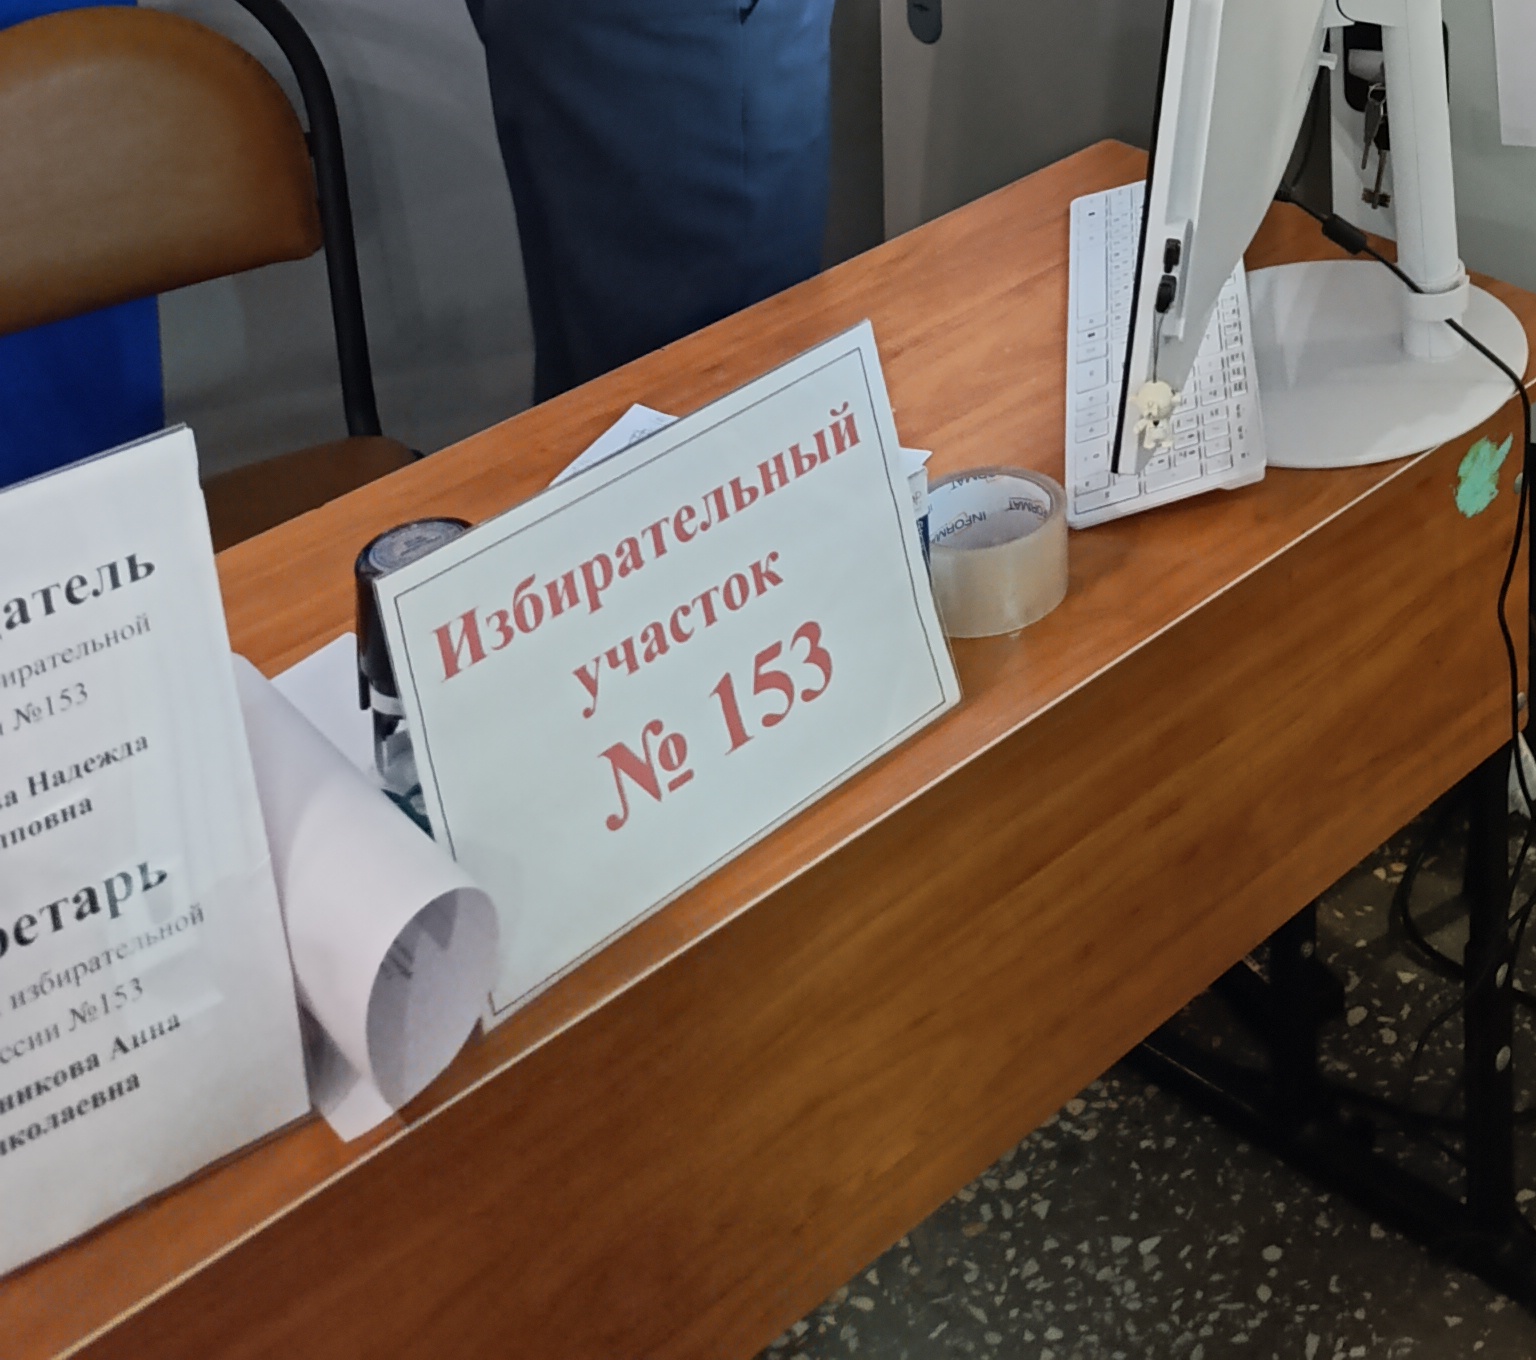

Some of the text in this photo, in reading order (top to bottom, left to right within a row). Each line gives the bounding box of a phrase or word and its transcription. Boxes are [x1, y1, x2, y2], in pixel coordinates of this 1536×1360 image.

[431, 401, 862, 684] Избирательный
[0, 553, 155, 632] атель
[571, 548, 785, 719] участок
[13, 682, 89, 731] №153
[597, 619, 834, 832] № 153
[27, 735, 149, 798] Надежда
[10, 902, 204, 1010] избирательной
[69, 977, 144, 1032] №153
[110, 1013, 181, 1062] Анна
